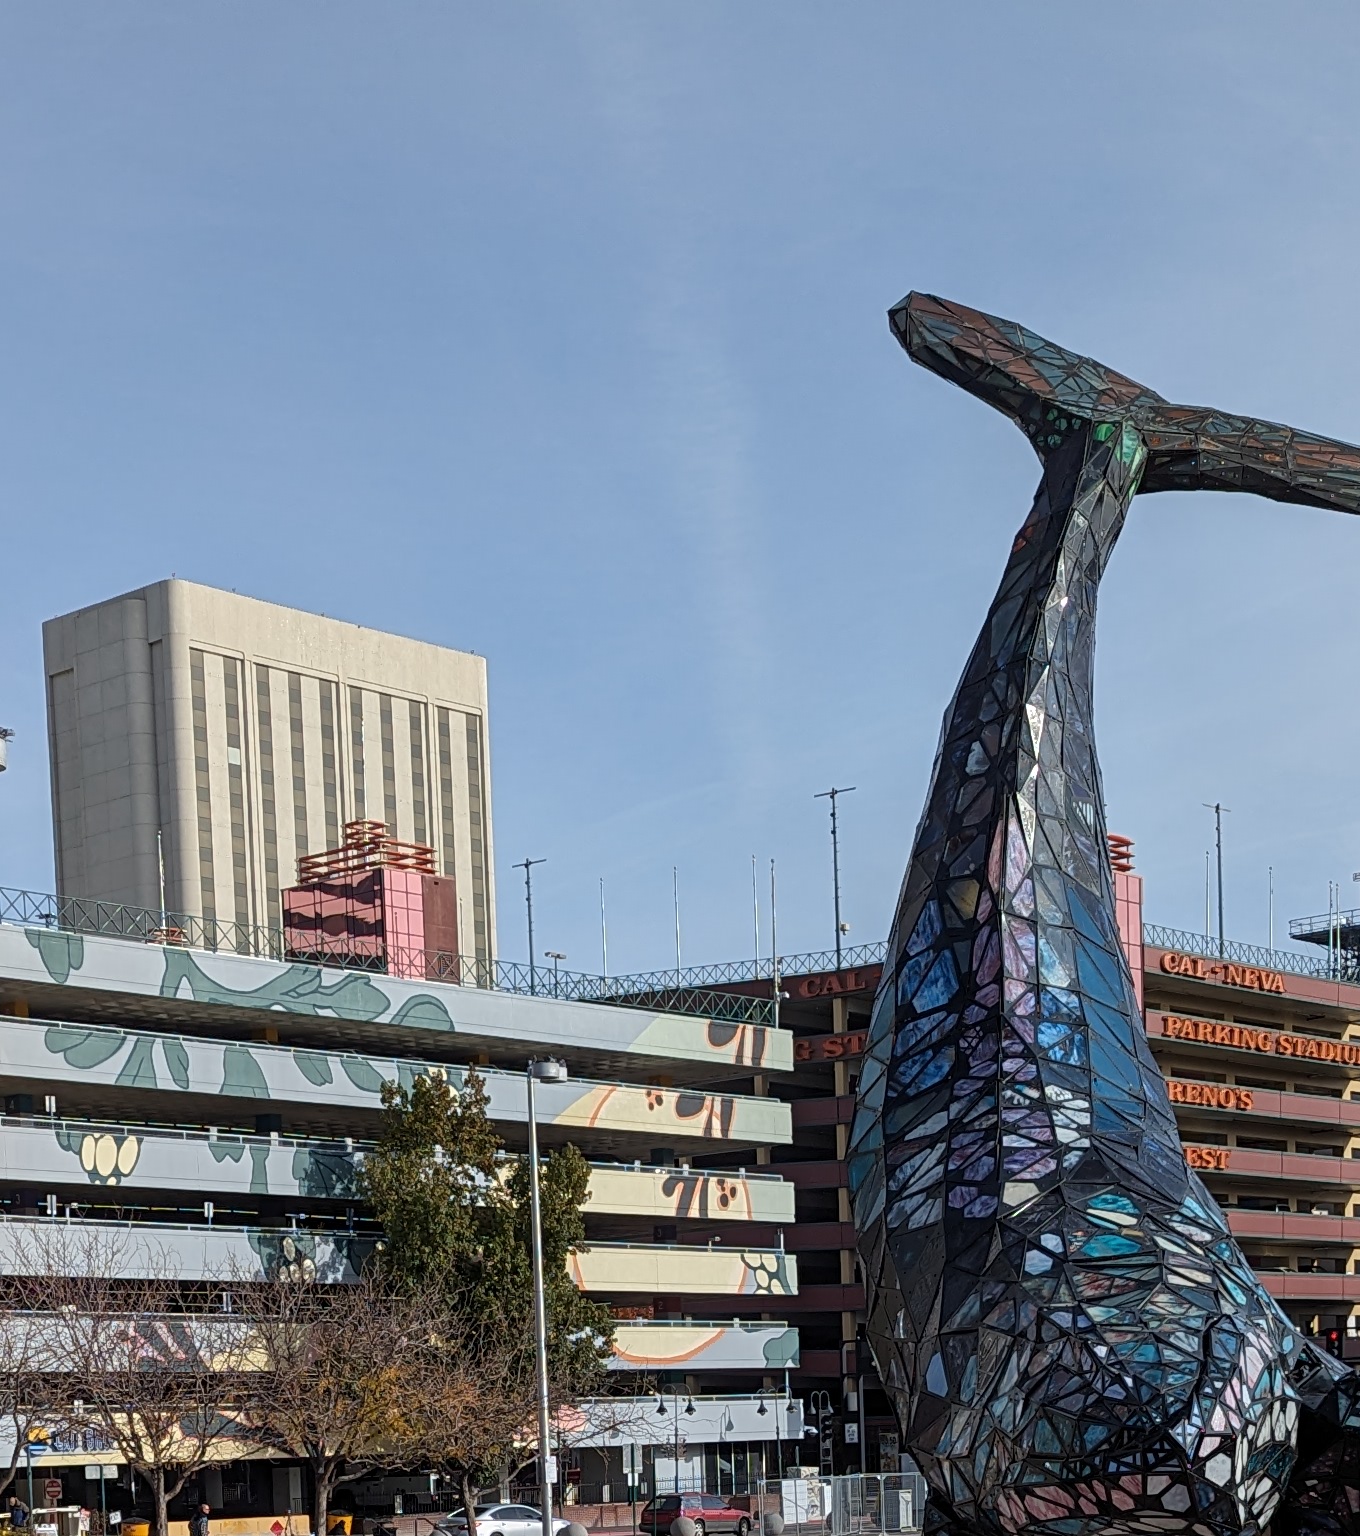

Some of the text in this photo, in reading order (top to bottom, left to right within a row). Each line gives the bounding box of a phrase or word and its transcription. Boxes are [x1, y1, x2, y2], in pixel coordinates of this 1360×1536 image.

[1160, 952, 1286, 994] CAL-NEVA
[1161, 1015, 1273, 1052] PARKING
[1167, 1080, 1254, 1111] RENO'S
[1184, 1146, 1232, 1170] EST
